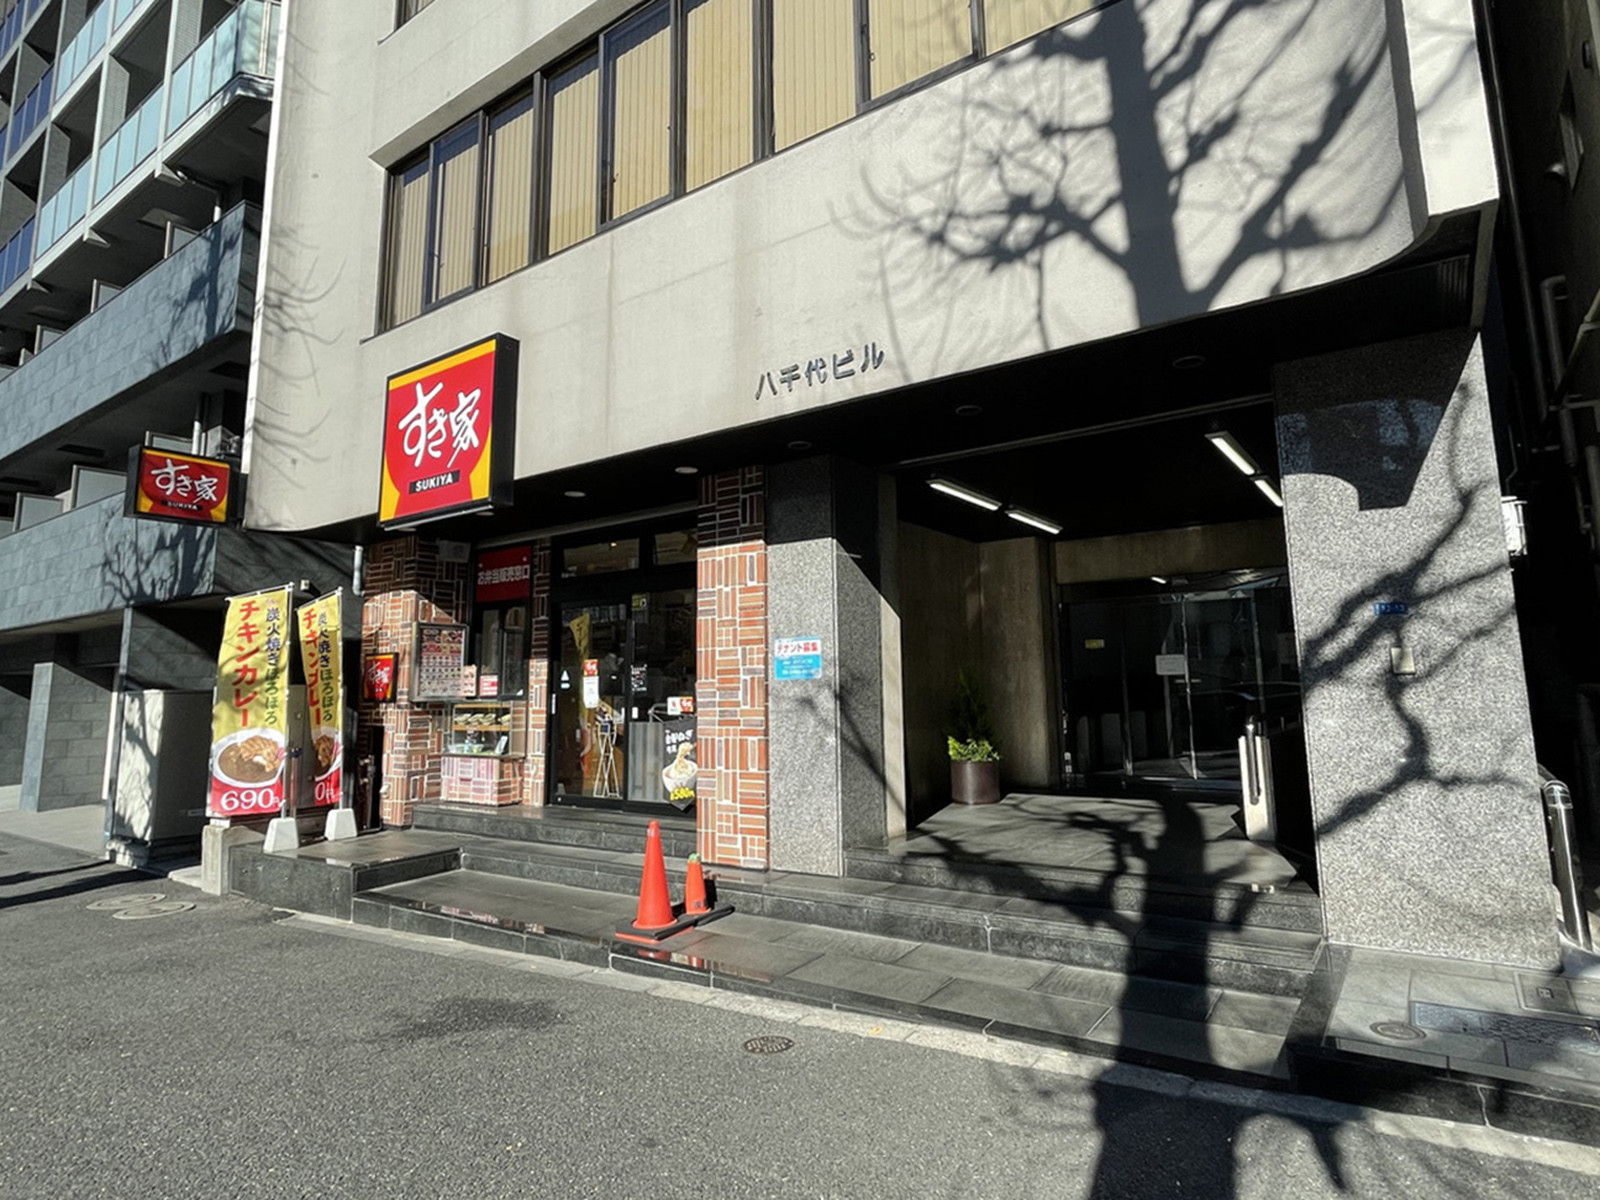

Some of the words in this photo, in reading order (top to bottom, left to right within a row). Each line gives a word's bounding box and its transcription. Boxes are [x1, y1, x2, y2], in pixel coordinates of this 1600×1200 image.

[755, 342, 884, 400] 八千代ビル
[398, 382, 481, 467] すき家
[151, 458, 218, 503] すき家
[166, 501, 198, 510] SUKIYA
[415, 473, 453, 492] SUKIYA
[232, 600, 261, 727] チキンカレー
[265, 607, 281, 725] 炭火焼きほろほろ
